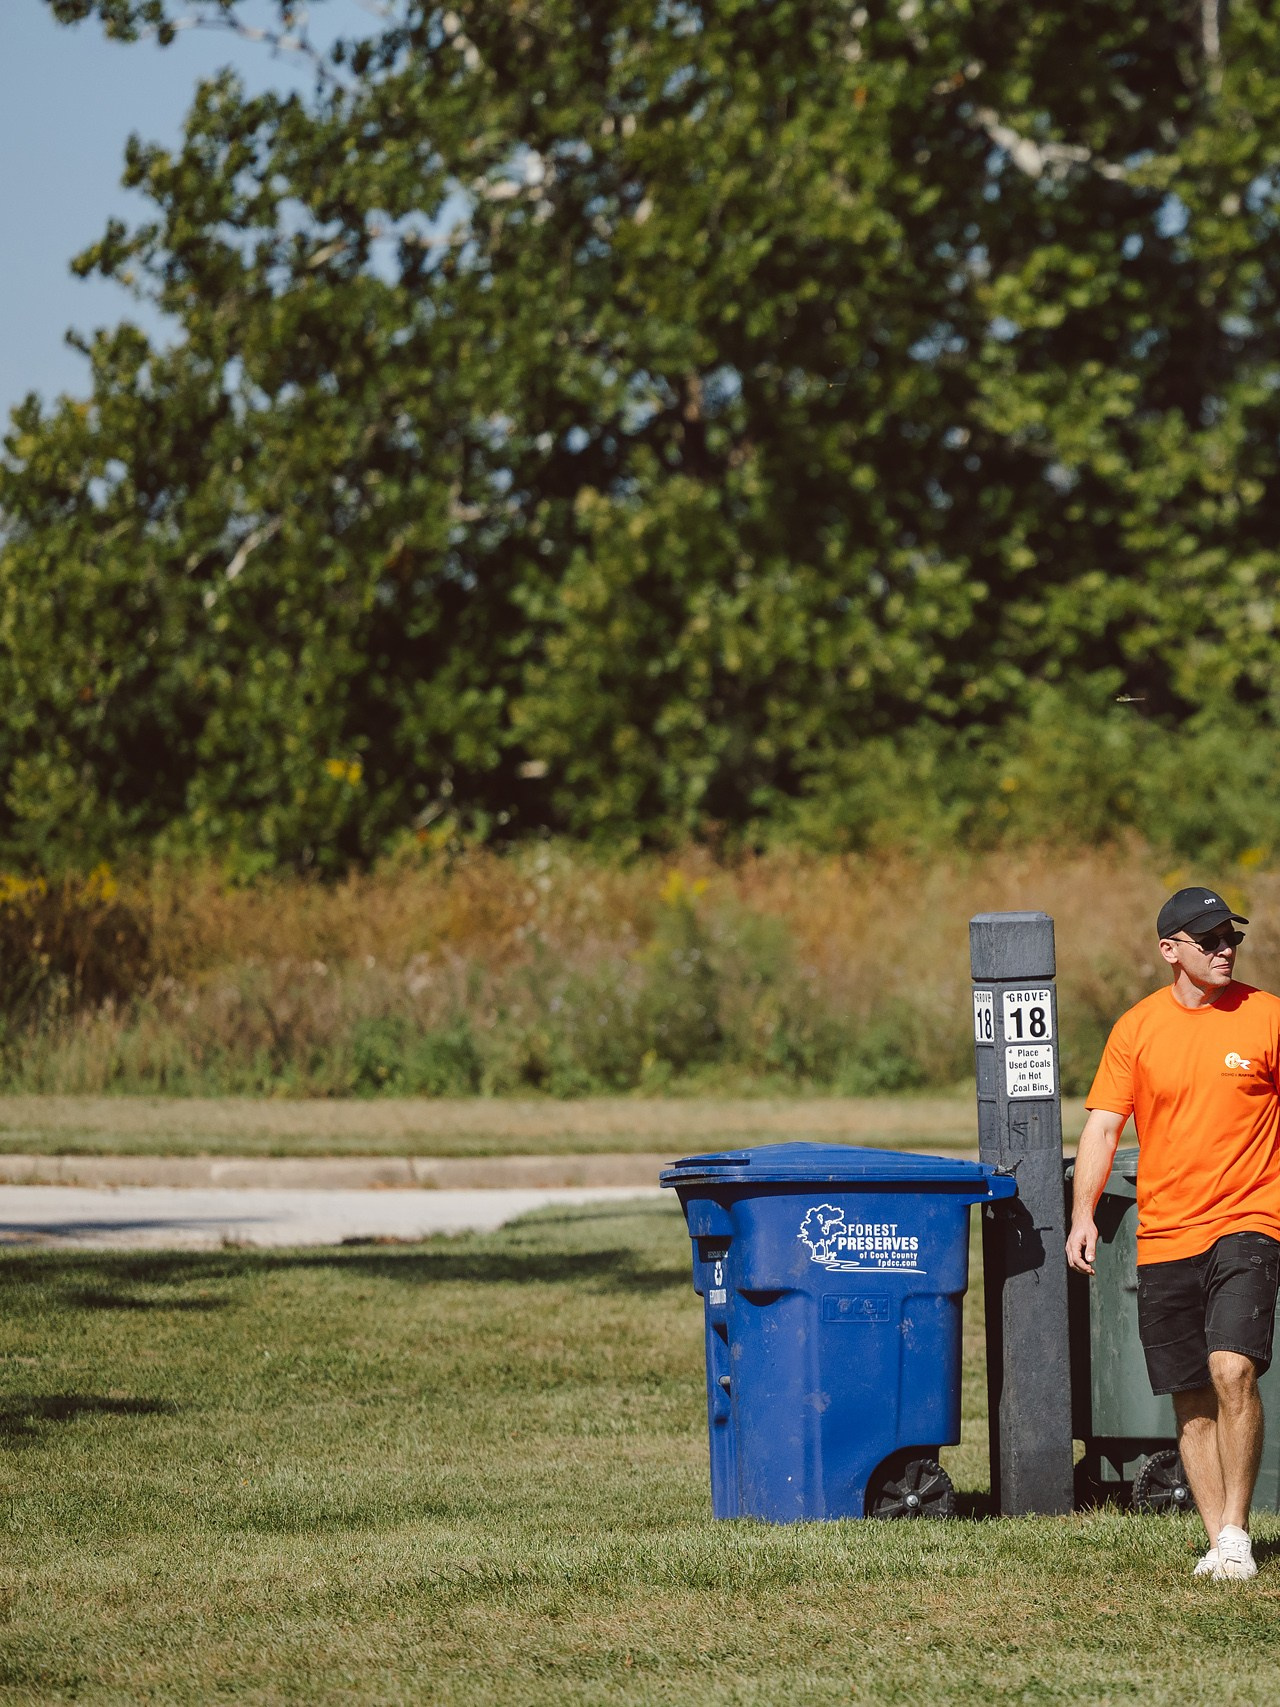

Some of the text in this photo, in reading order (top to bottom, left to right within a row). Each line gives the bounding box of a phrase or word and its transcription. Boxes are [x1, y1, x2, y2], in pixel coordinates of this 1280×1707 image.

[1009, 992, 1044, 1002] GROVE
[977, 1008, 992, 1039] 18
[1010, 1007, 1046, 1038] 18
[1017, 1049, 1039, 1057] Place
[1009, 1060, 1051, 1069] Used Coals
[1019, 1071, 1041, 1080] in Hot
[1013, 1083, 1049, 1092] Coal Bins
[848, 1224, 898, 1236] FOREST
[837, 1237, 919, 1250] PRESERVES
[860, 1251, 918, 1260] of Cook County
[878, 1259, 917, 1268] fpdcc.com
